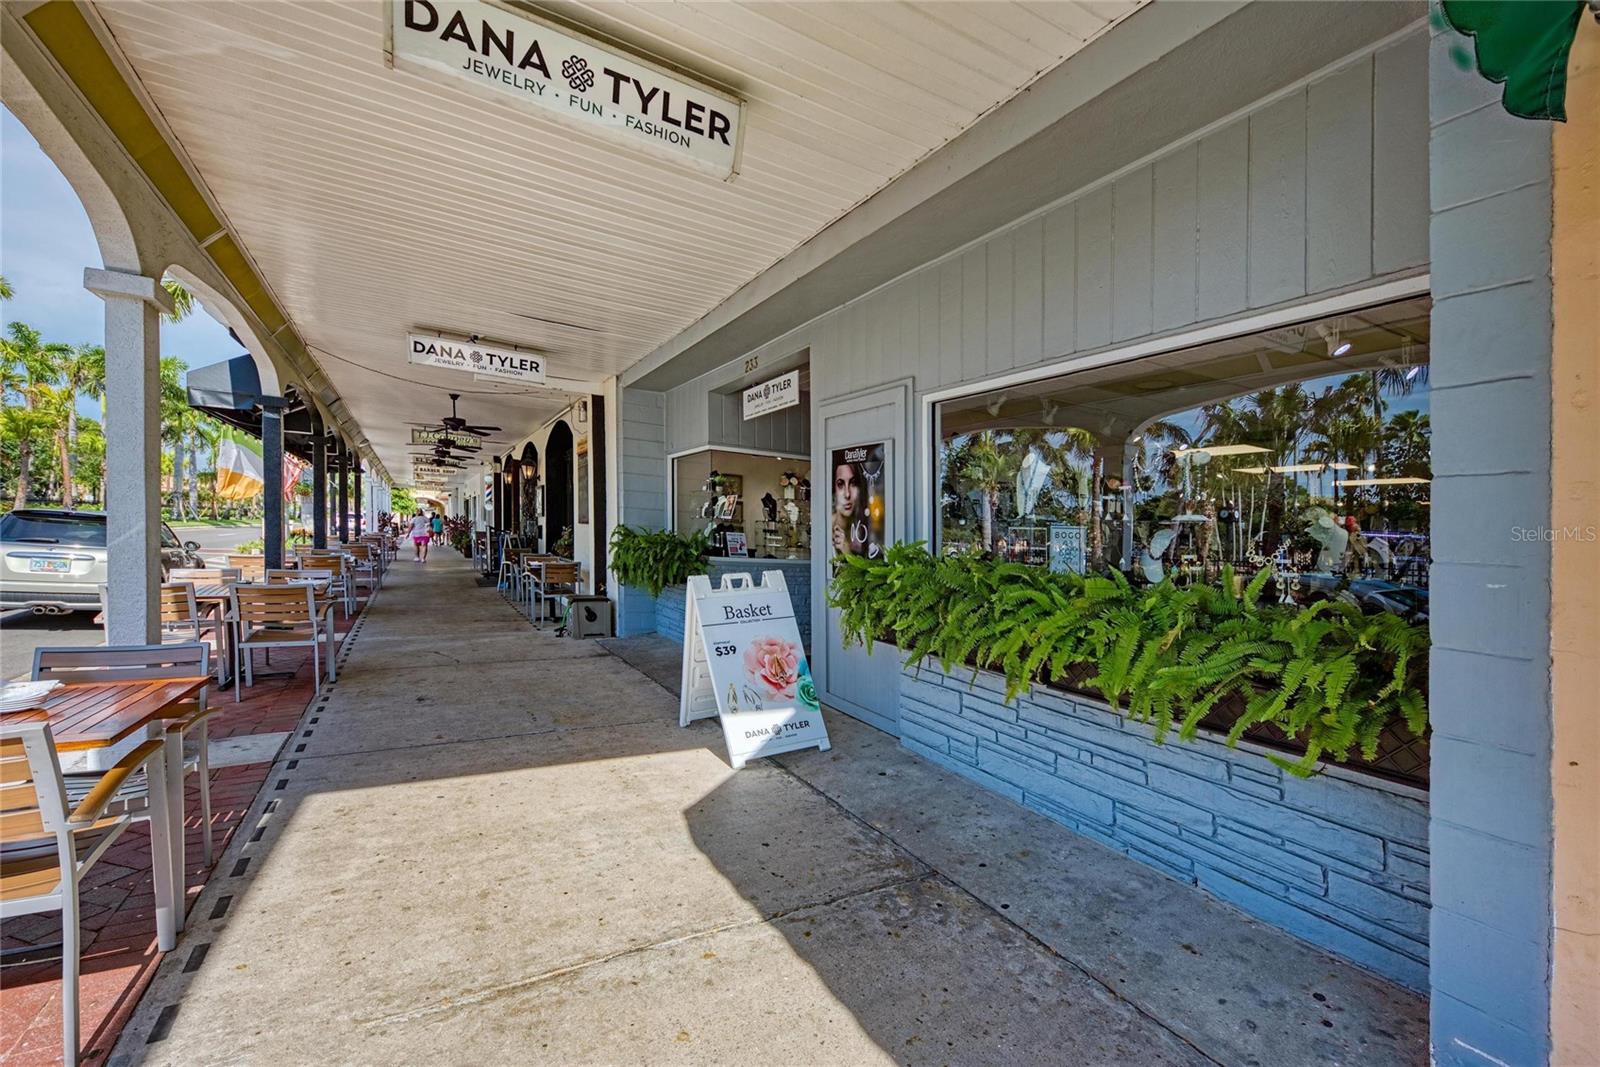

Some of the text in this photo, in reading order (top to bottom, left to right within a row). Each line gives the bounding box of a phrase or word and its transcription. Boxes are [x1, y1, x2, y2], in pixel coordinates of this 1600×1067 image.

[404, 0, 731, 146] DANA TYLER
[463, 57, 691, 149] JEWELRY FUN FASHION
[413, 340, 540, 373] DANA TYLER
[745, 355, 759, 373] 233
[434, 358, 465, 367] JEWELRY
[495, 367, 523, 376] FASHION
[747, 390, 763, 403] DANA
[771, 378, 792, 394] TYLER
[1055, 531, 1081, 540] BOGO
[722, 603, 773, 621] Basket
[715, 645, 737, 657] $39
[744, 728, 770, 739] DANA
[783, 720, 811, 731] TYLER
